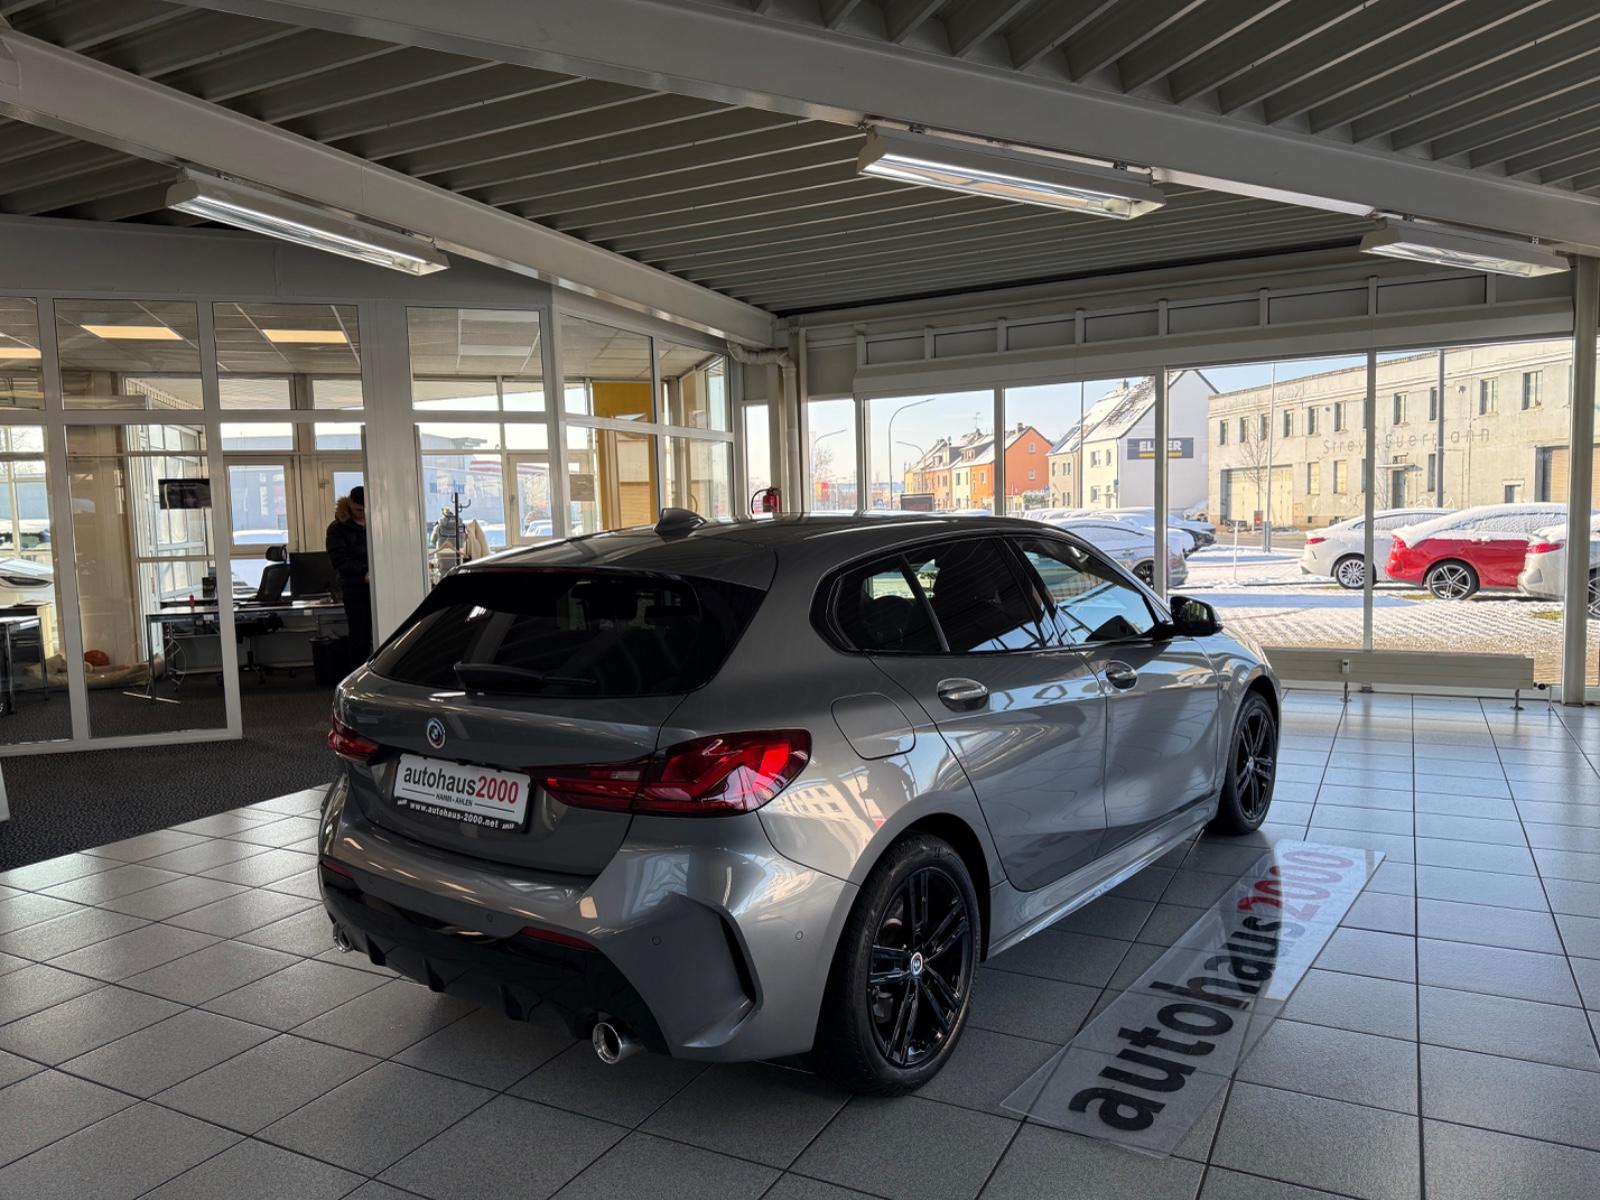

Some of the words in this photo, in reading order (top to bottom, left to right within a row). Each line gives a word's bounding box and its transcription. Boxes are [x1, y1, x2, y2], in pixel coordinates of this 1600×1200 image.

[1139, 440, 1182, 452] ELER
[403, 766, 519, 805] autohaus2000
[409, 802, 499, 829] www.autohaus-2000.net
[1068, 849, 1355, 1132] autohaus2000
